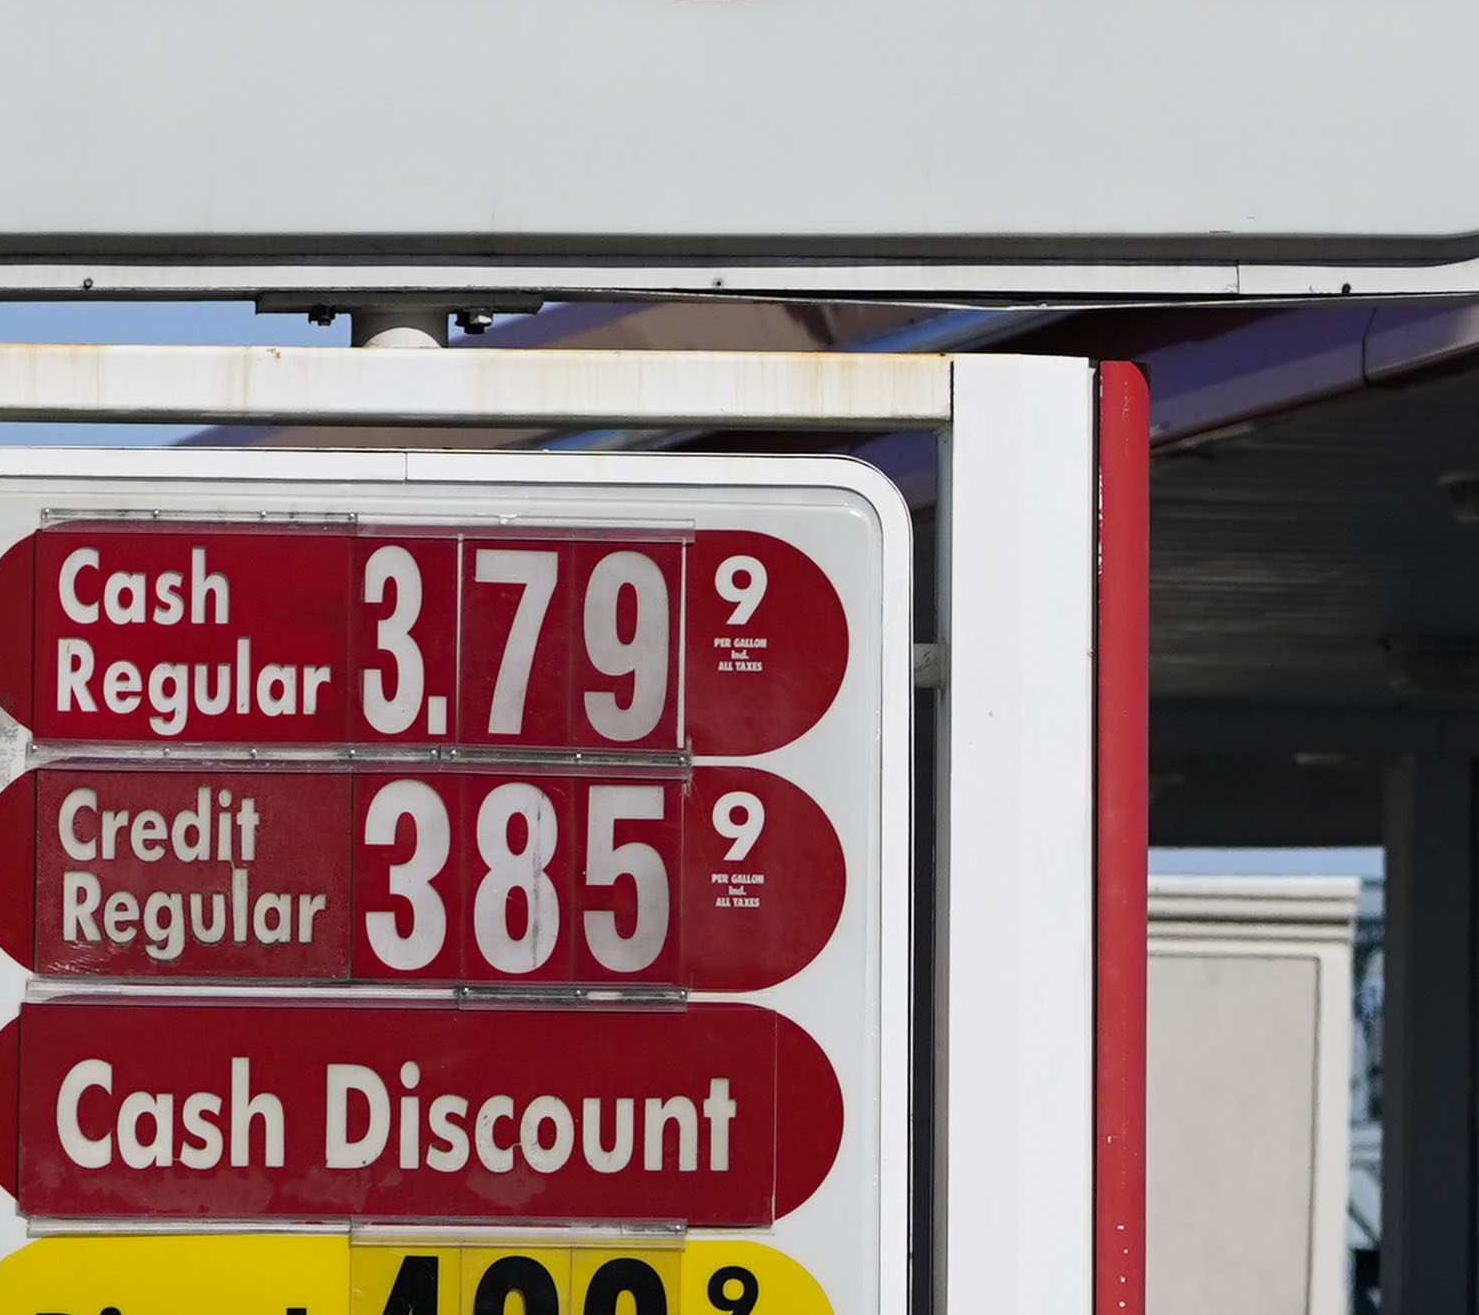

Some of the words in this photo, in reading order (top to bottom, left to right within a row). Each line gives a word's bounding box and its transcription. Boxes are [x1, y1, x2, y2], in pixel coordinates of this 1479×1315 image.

[57, 546, 230, 626] Cash
[714, 555, 768, 625] 9
[713, 637, 732, 648] PER
[733, 637, 768, 649] GALLON
[717, 661, 734, 672] ALL
[735, 661, 764, 672] TAXES
[57, 638, 331, 736] Regular
[57, 786, 261, 864] Credit
[62, 867, 327, 962] Regular
[363, 778, 671, 975] 385
[712, 791, 766, 861] 9
[711, 873, 729, 884] PER
[731, 873, 765, 884] GALLON
[715, 896, 732, 907] ALL
[732, 896, 761, 908] TAXES
[55, 1057, 286, 1171] Cash
[325, 1061, 738, 1175] Discount
